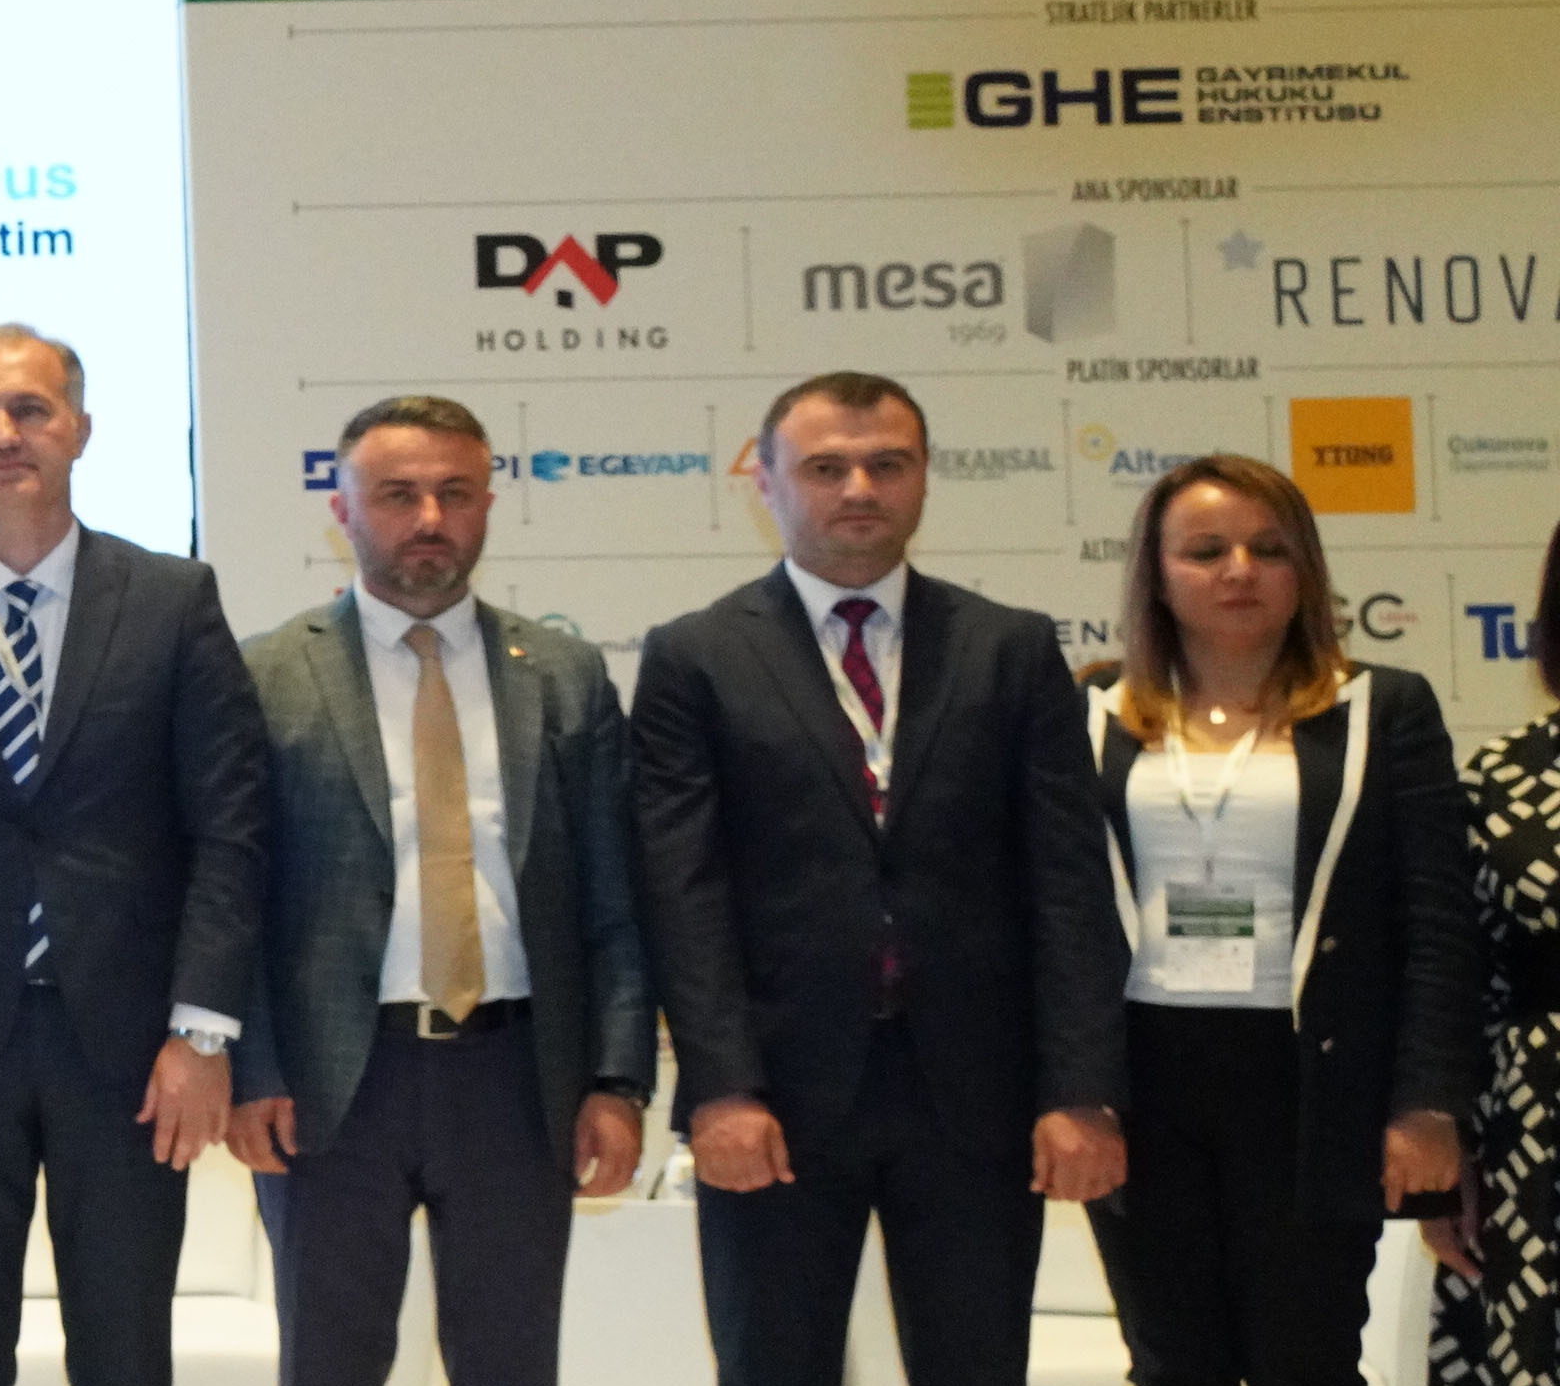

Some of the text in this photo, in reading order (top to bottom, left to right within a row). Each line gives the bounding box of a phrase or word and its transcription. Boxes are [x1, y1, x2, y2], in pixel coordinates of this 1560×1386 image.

[964, 69, 1184, 128] GHE
[1197, 85, 1334, 103] HUKUKU
[475, 232, 663, 308] DAP
[803, 259, 1004, 311] mesa
[1273, 254, 1560, 327] RENOV
[476, 326, 669, 353] HOLDING
